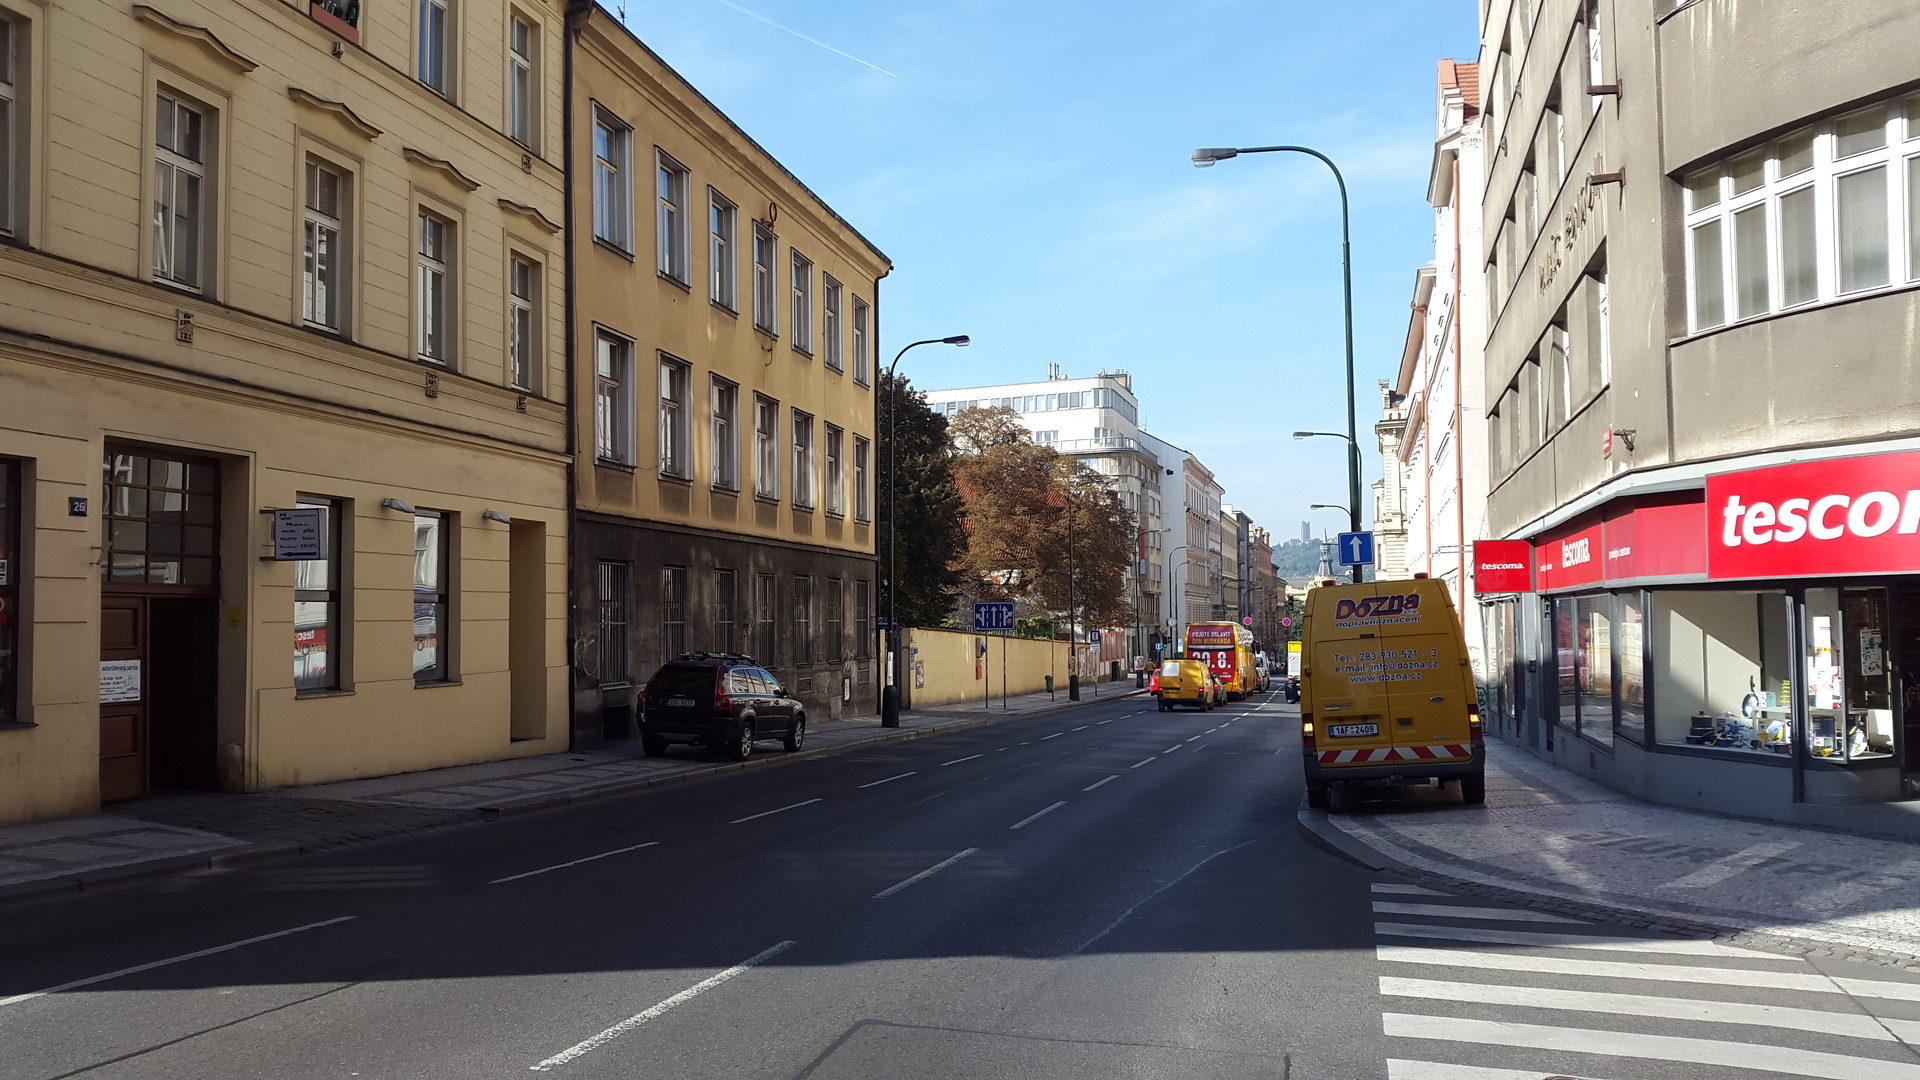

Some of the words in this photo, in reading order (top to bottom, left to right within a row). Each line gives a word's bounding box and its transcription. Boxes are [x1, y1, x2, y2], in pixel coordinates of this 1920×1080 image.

[74, 502, 84, 512] 26
[1562, 537, 1590, 568] tescoma.
[1336, 619, 1379, 628] dopravní
[1381, 615, 1422, 624] značení
[1359, 652, 1377, 661] 283
[1380, 651, 1398, 660] 930
[1401, 650, 1418, 659] 521
[1431, 648, 1437, 657] 3
[1371, 660, 1439, 671] info@dozna.cz
[1350, 672, 1422, 683] www.dozna.cz
